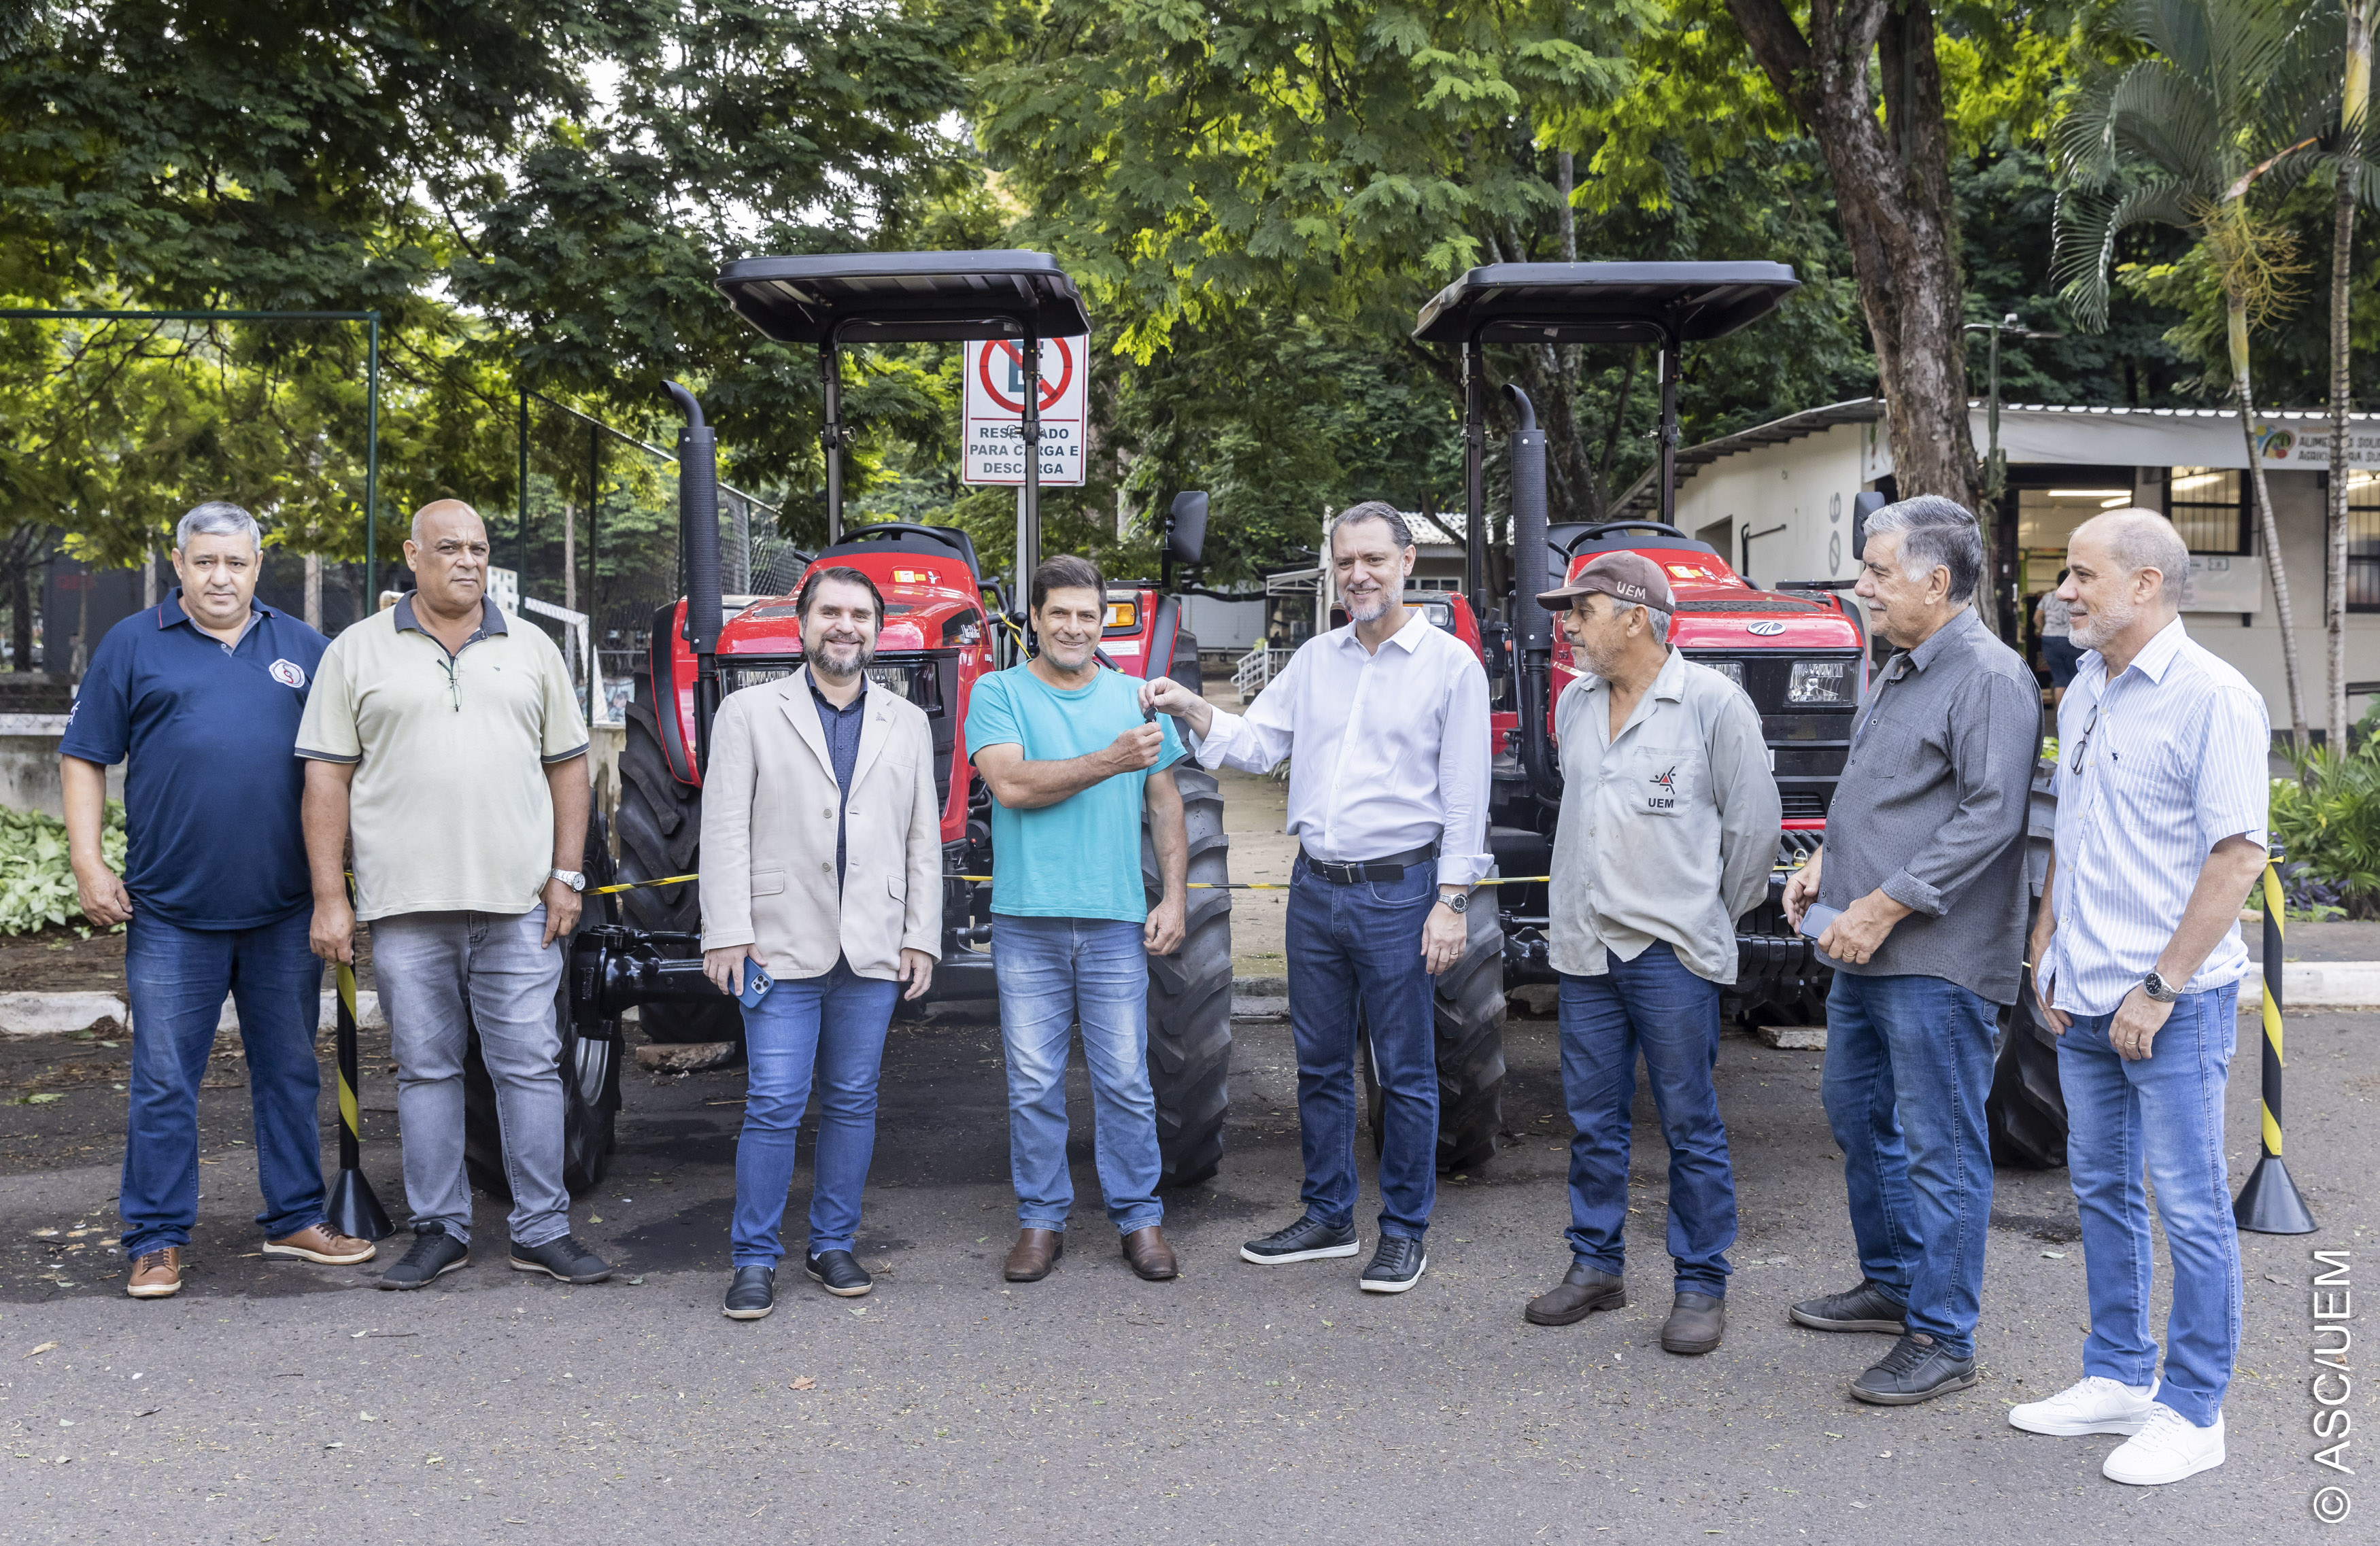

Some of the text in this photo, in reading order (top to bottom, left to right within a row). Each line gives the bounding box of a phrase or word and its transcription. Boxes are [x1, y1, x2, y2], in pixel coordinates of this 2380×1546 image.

[980, 427, 1069, 439] RESEADO
[970, 444, 1078, 456] PARA CRGA E
[983, 462, 1064, 474] DESCGA
[1616, 581, 1646, 600] UEM
[1648, 797, 1674, 808] UEM
